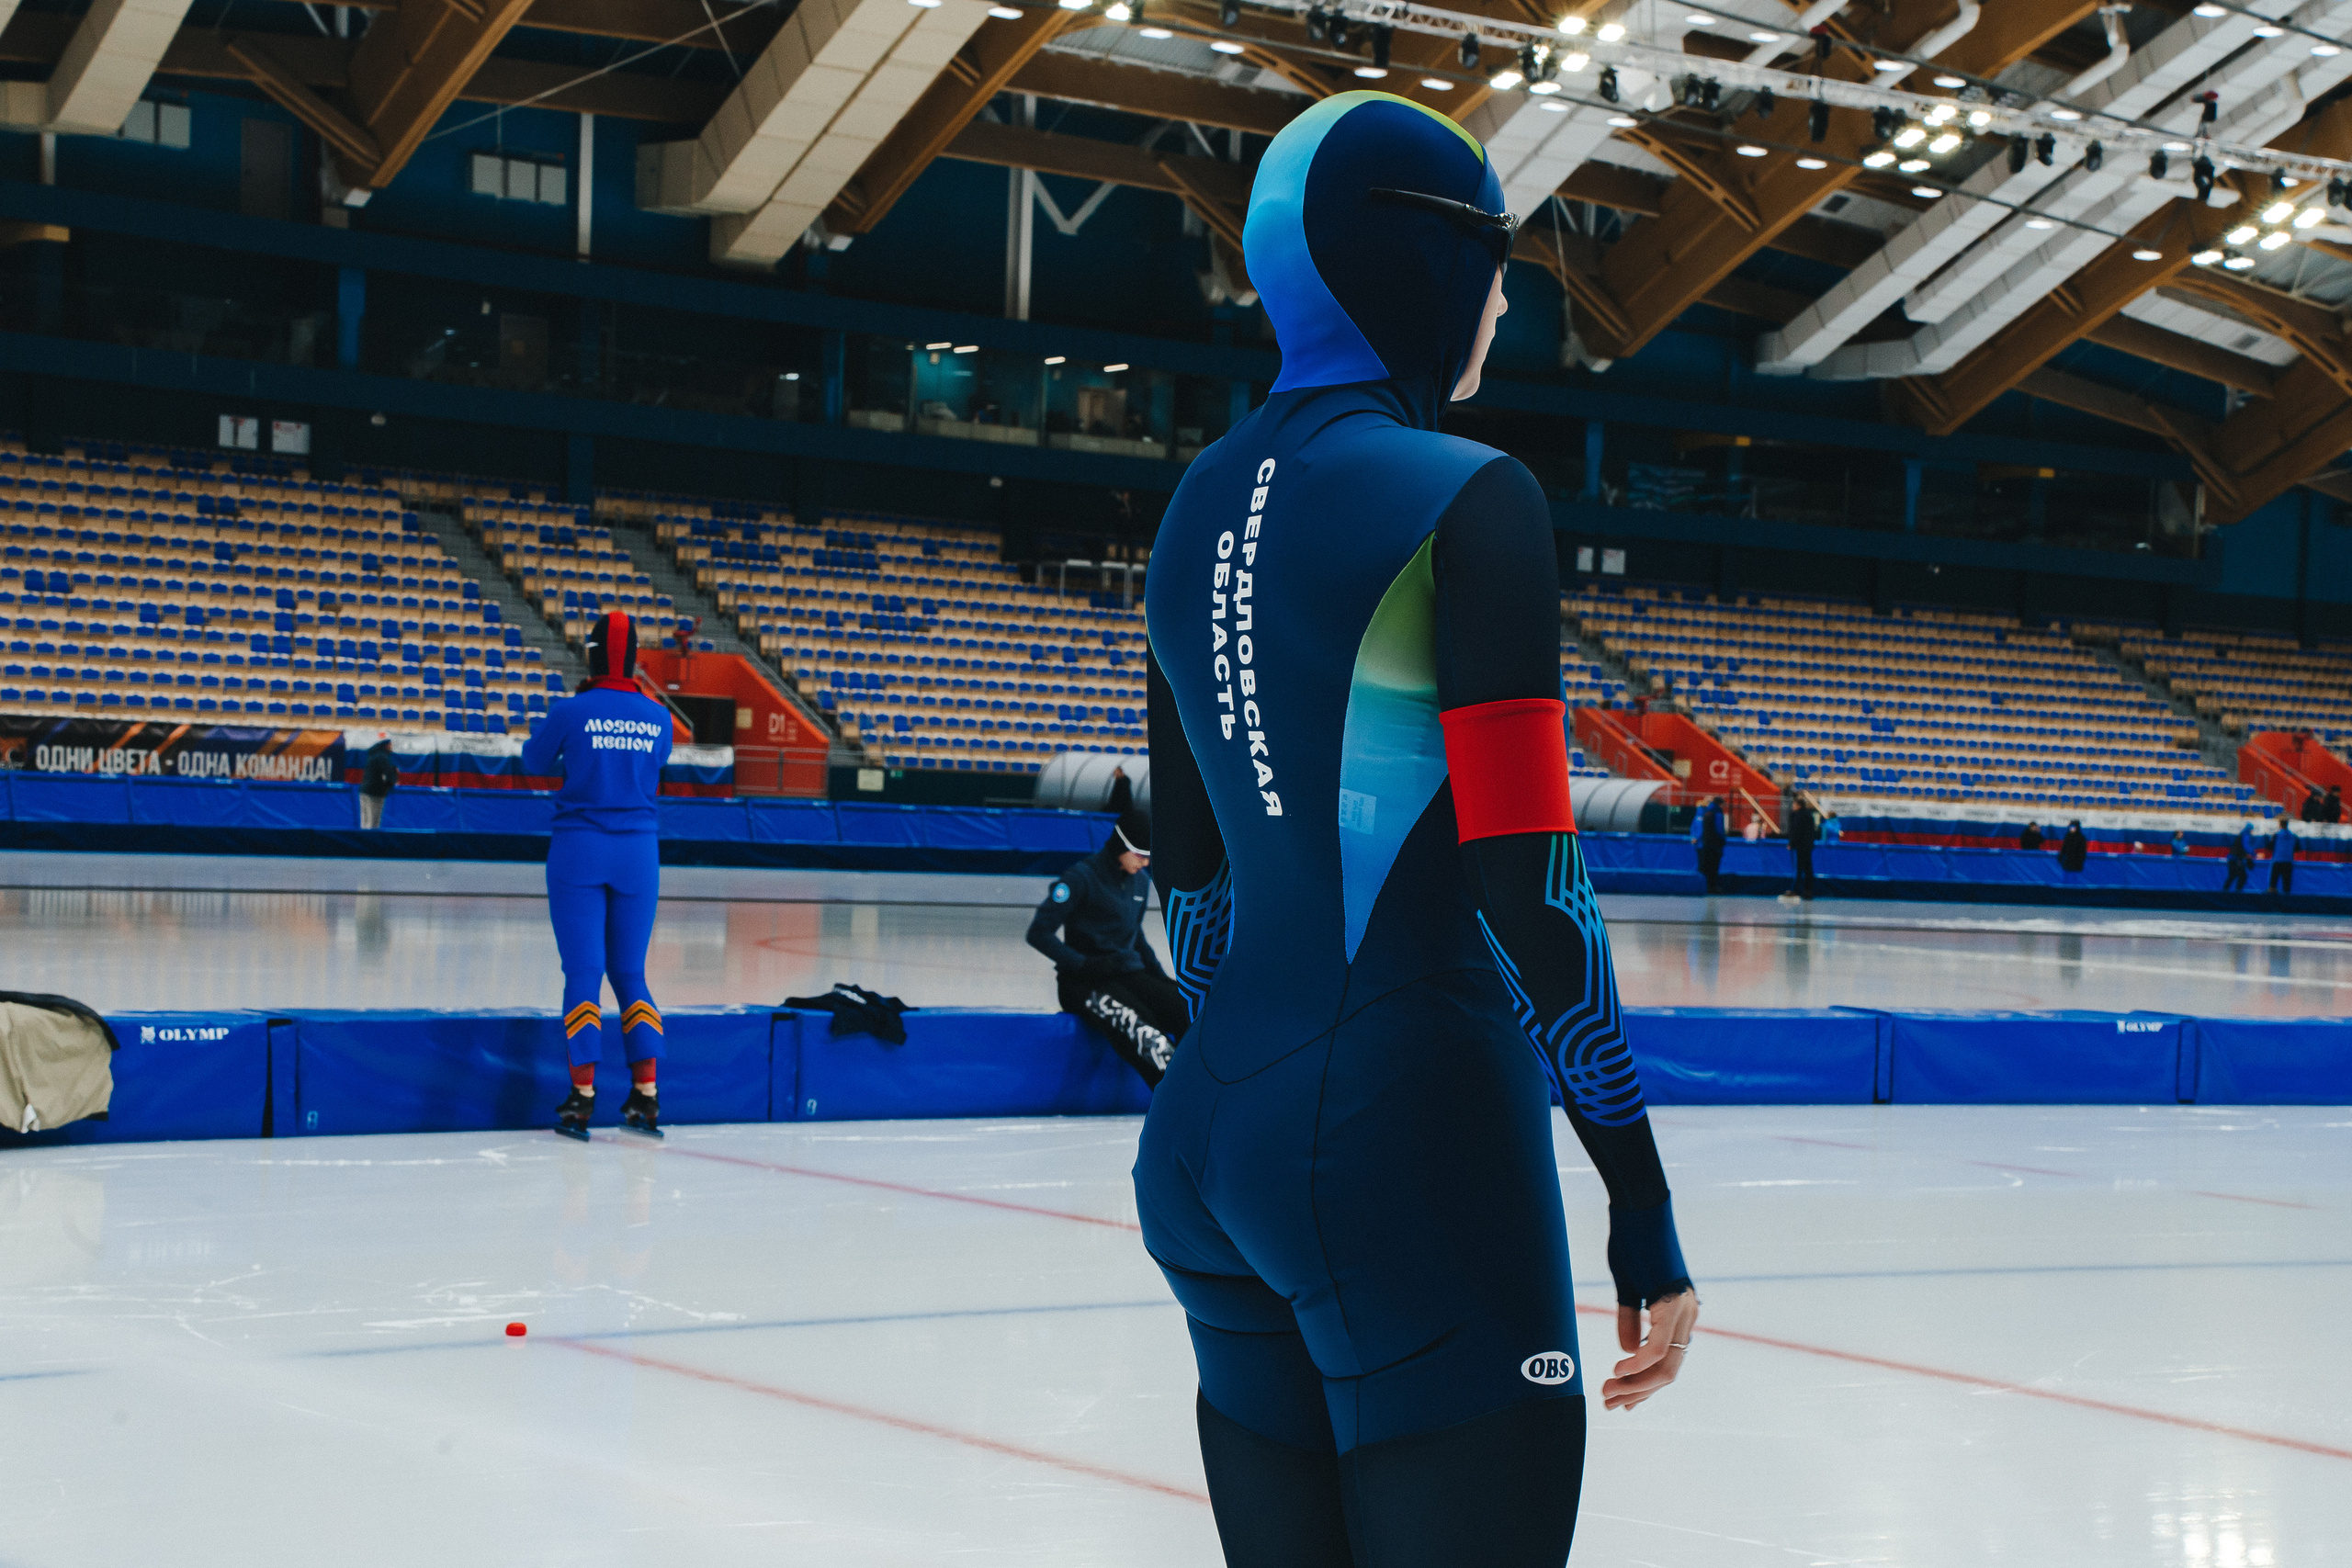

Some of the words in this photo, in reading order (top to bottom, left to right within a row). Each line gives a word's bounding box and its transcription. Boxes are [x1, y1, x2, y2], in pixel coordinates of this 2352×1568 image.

[1212, 530, 1237, 740] ОБЛАСТЬ
[1233, 457, 1283, 817] СВЕРДЛОВСКАЯ
[584, 718, 662, 738] MOSCOW
[769, 712, 786, 734] D1
[592, 735, 654, 753] REGION
[36, 745, 94, 773] ОДНИ
[97, 748, 161, 775] ЦВЕТА
[177, 751, 230, 778] ОДНА
[235, 753, 333, 782] КОМАНДА!
[1709, 760, 1729, 779] C2
[159, 1027, 230, 1041] OLYMP
[1528, 1358, 1570, 1379] OBS
